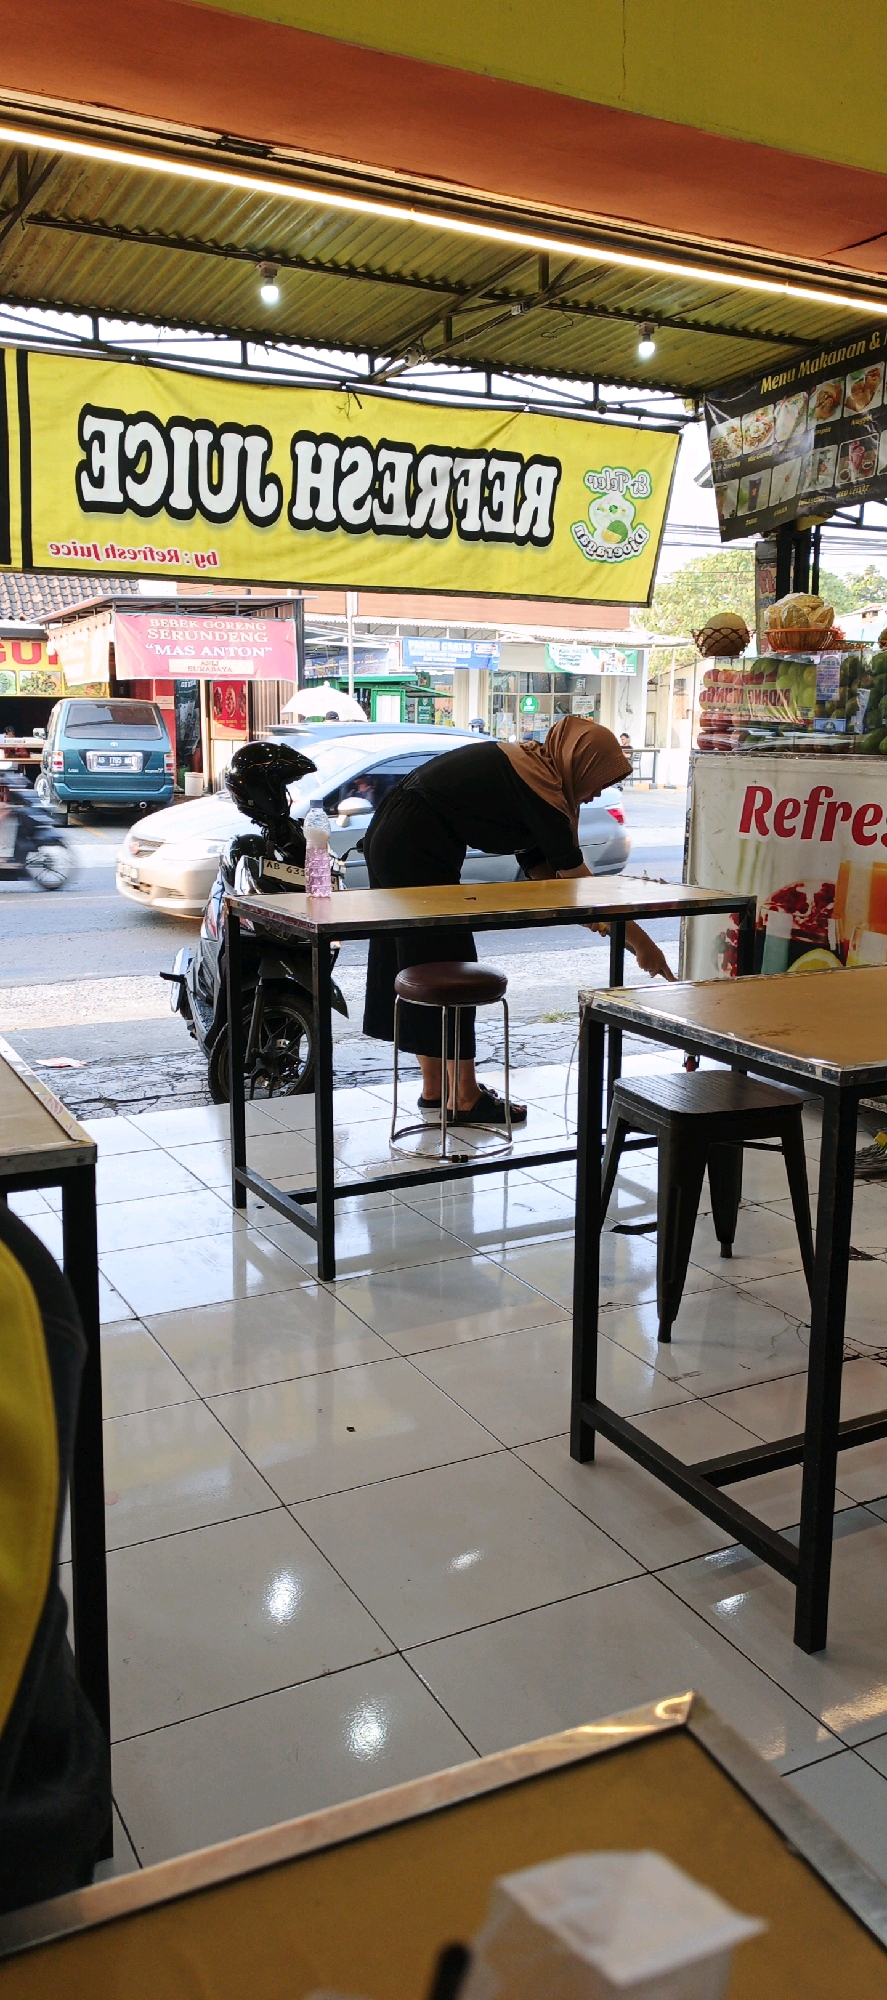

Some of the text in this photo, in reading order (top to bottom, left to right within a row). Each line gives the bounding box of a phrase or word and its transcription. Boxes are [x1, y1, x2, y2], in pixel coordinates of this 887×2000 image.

[759, 373, 796, 396] Menu
[797, 340, 867, 378] Makanan
[869, 332, 881, 351] &
[149, 618, 267, 631] BEBEK GORENG
[146, 628, 269, 643] SERUNDENG
[145, 643, 273, 658] “MAS ANTON”
[739, 785, 887, 847] Refre
[266, 860, 280, 871] AB
